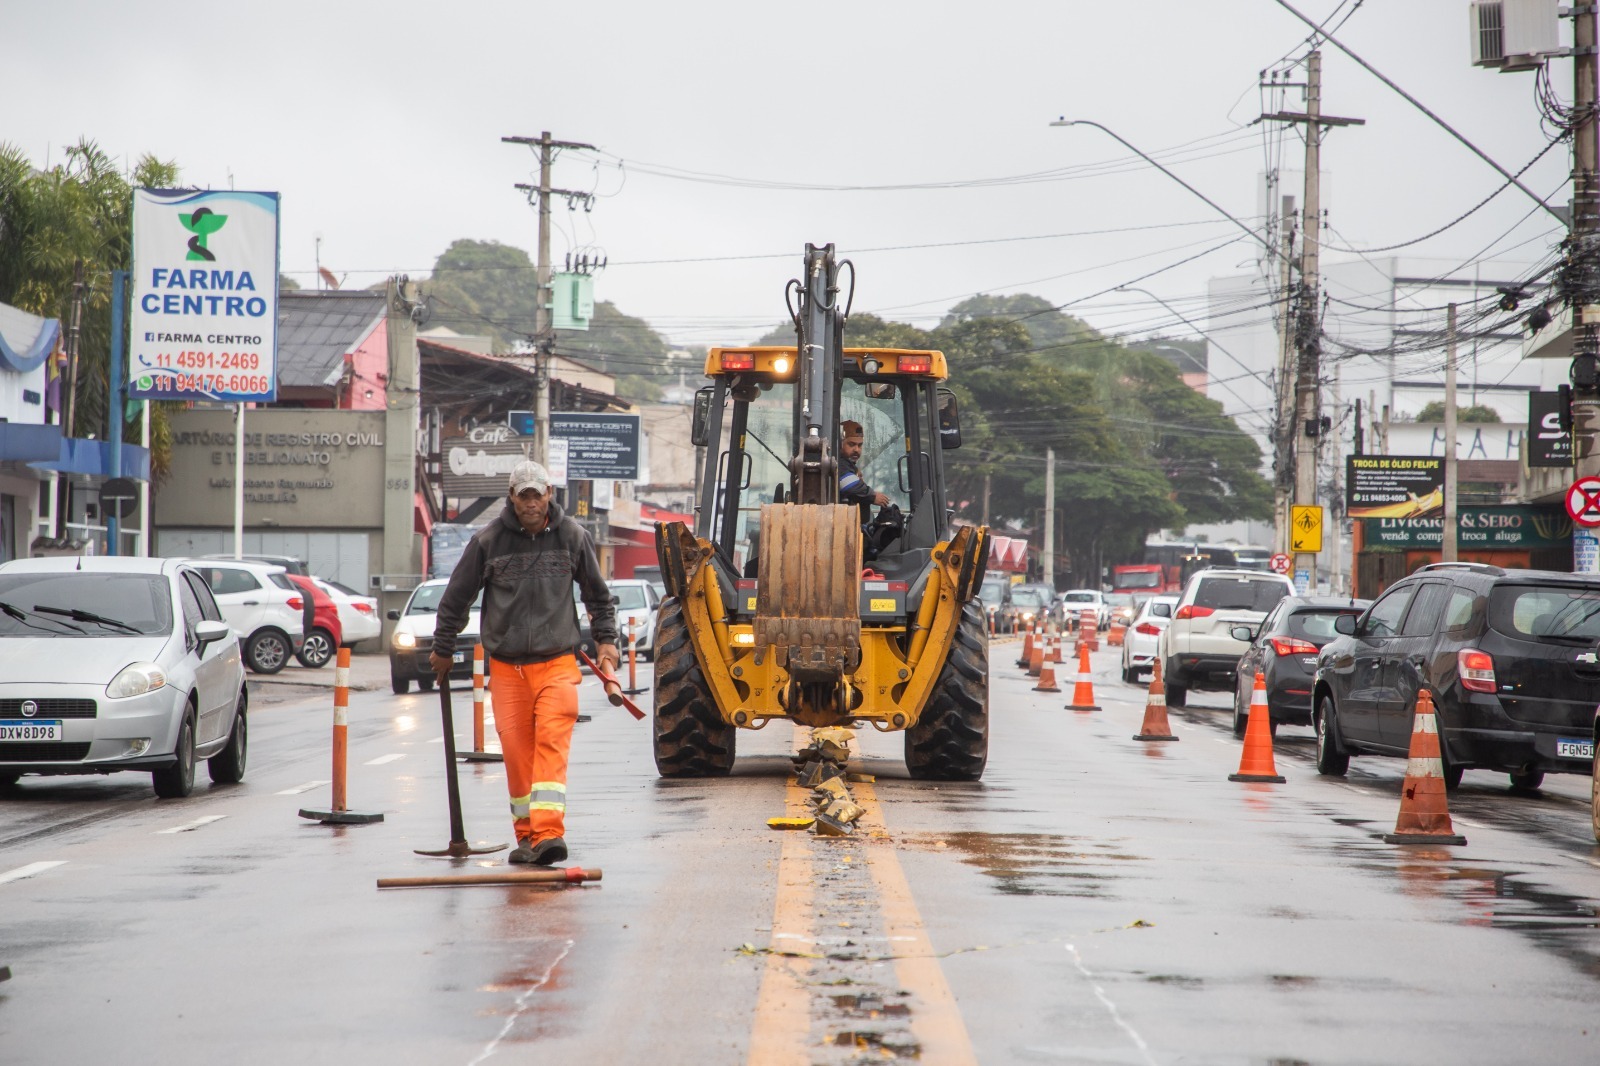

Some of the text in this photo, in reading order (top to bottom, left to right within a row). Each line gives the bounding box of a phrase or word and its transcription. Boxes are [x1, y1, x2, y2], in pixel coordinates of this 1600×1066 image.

[152, 268, 256, 291] FARMA
[141, 293, 267, 317] CENTRO
[157, 333, 262, 345] FARMA CENTRO
[156, 351, 259, 370] 11 4591-2469
[156, 373, 269, 394] 11 94176-6066
[172, 430, 237, 447] ARTÓRIO
[265, 432, 342, 447] REGISTRO
[346, 432, 384, 447] CIVIL
[469, 426, 510, 446] Café
[212, 451, 331, 465] E TBELIONATO
[1353, 458, 1439, 468] TROCA DE ÓLEO FELIPE
[233, 477, 275, 489] oberto
[1381, 518, 1445, 528] LIVRARI
[1460, 513, 1477, 528] &
[1380, 528, 1522, 545] vende comp troca aluga
[0, 727, 55, 739] DXW8D98
